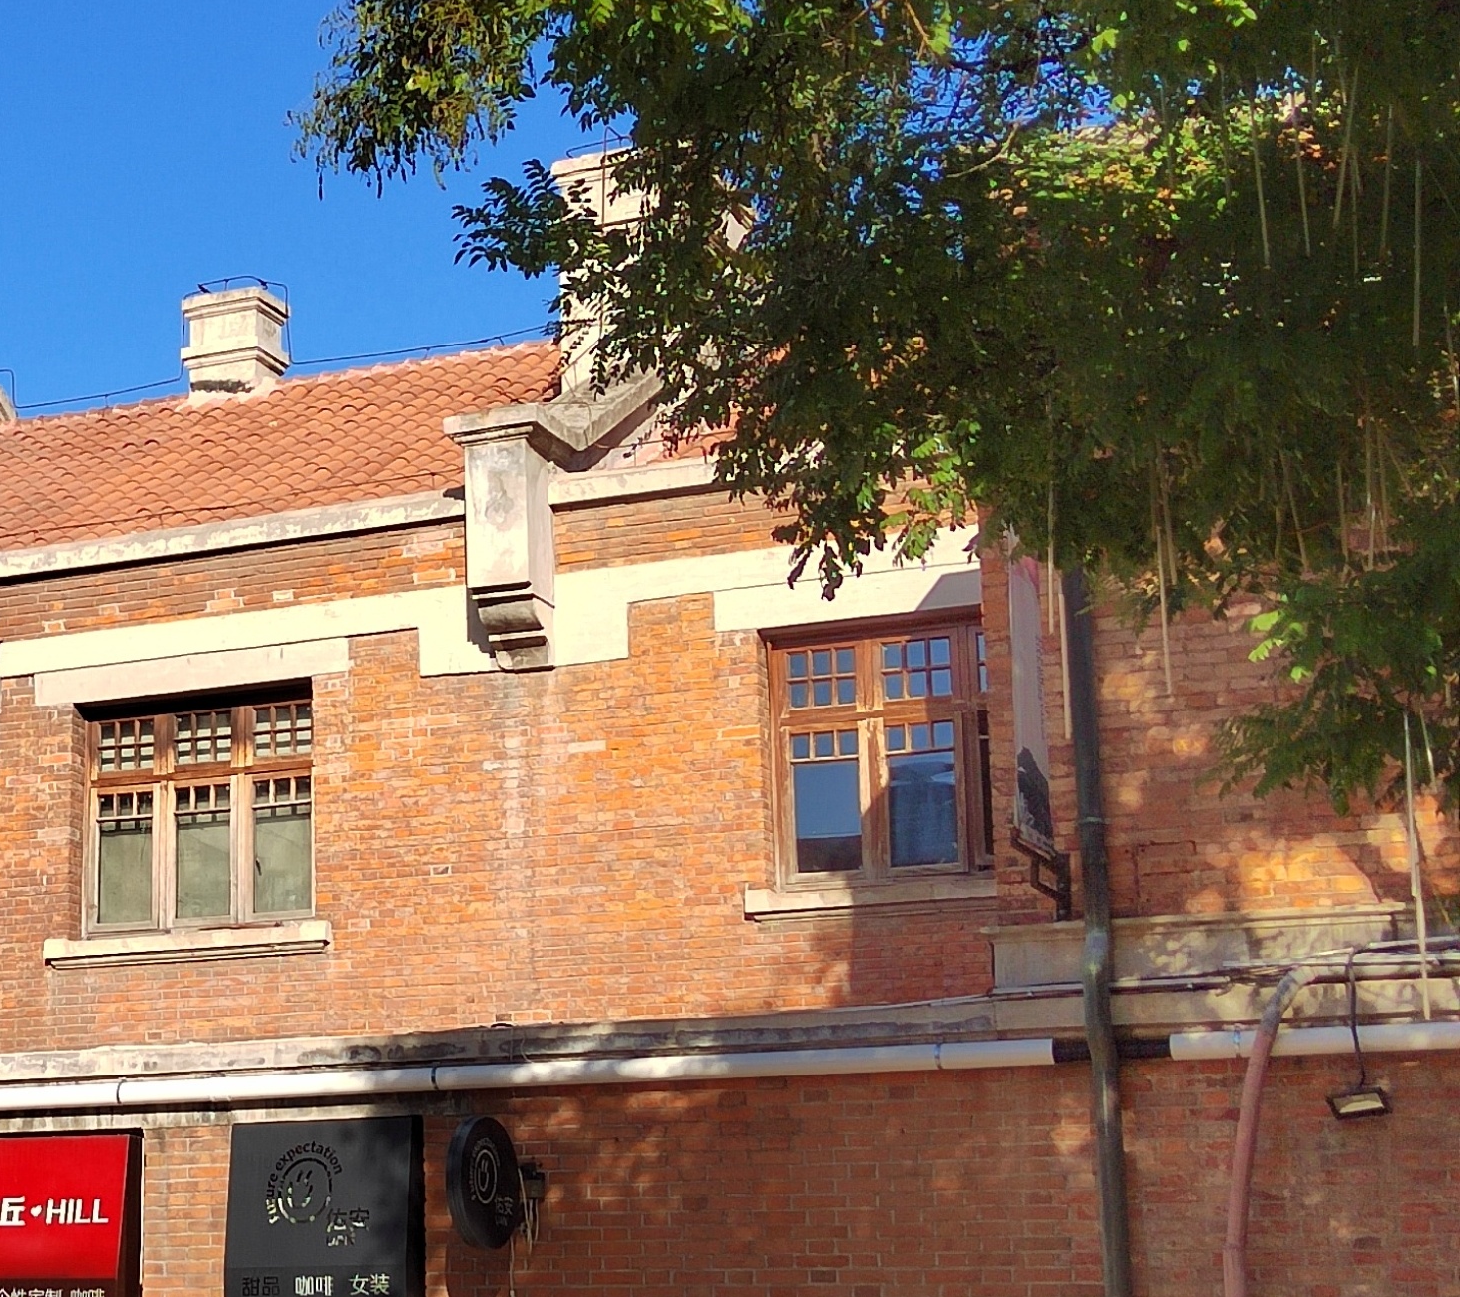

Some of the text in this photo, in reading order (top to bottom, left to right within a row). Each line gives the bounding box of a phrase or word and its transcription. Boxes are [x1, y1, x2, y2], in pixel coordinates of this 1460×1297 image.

[275, 1140, 343, 1175] expectation
[45, 1197, 109, 1225] HILL
[242, 1272, 390, 1297] 甜品 咖啡 女装
